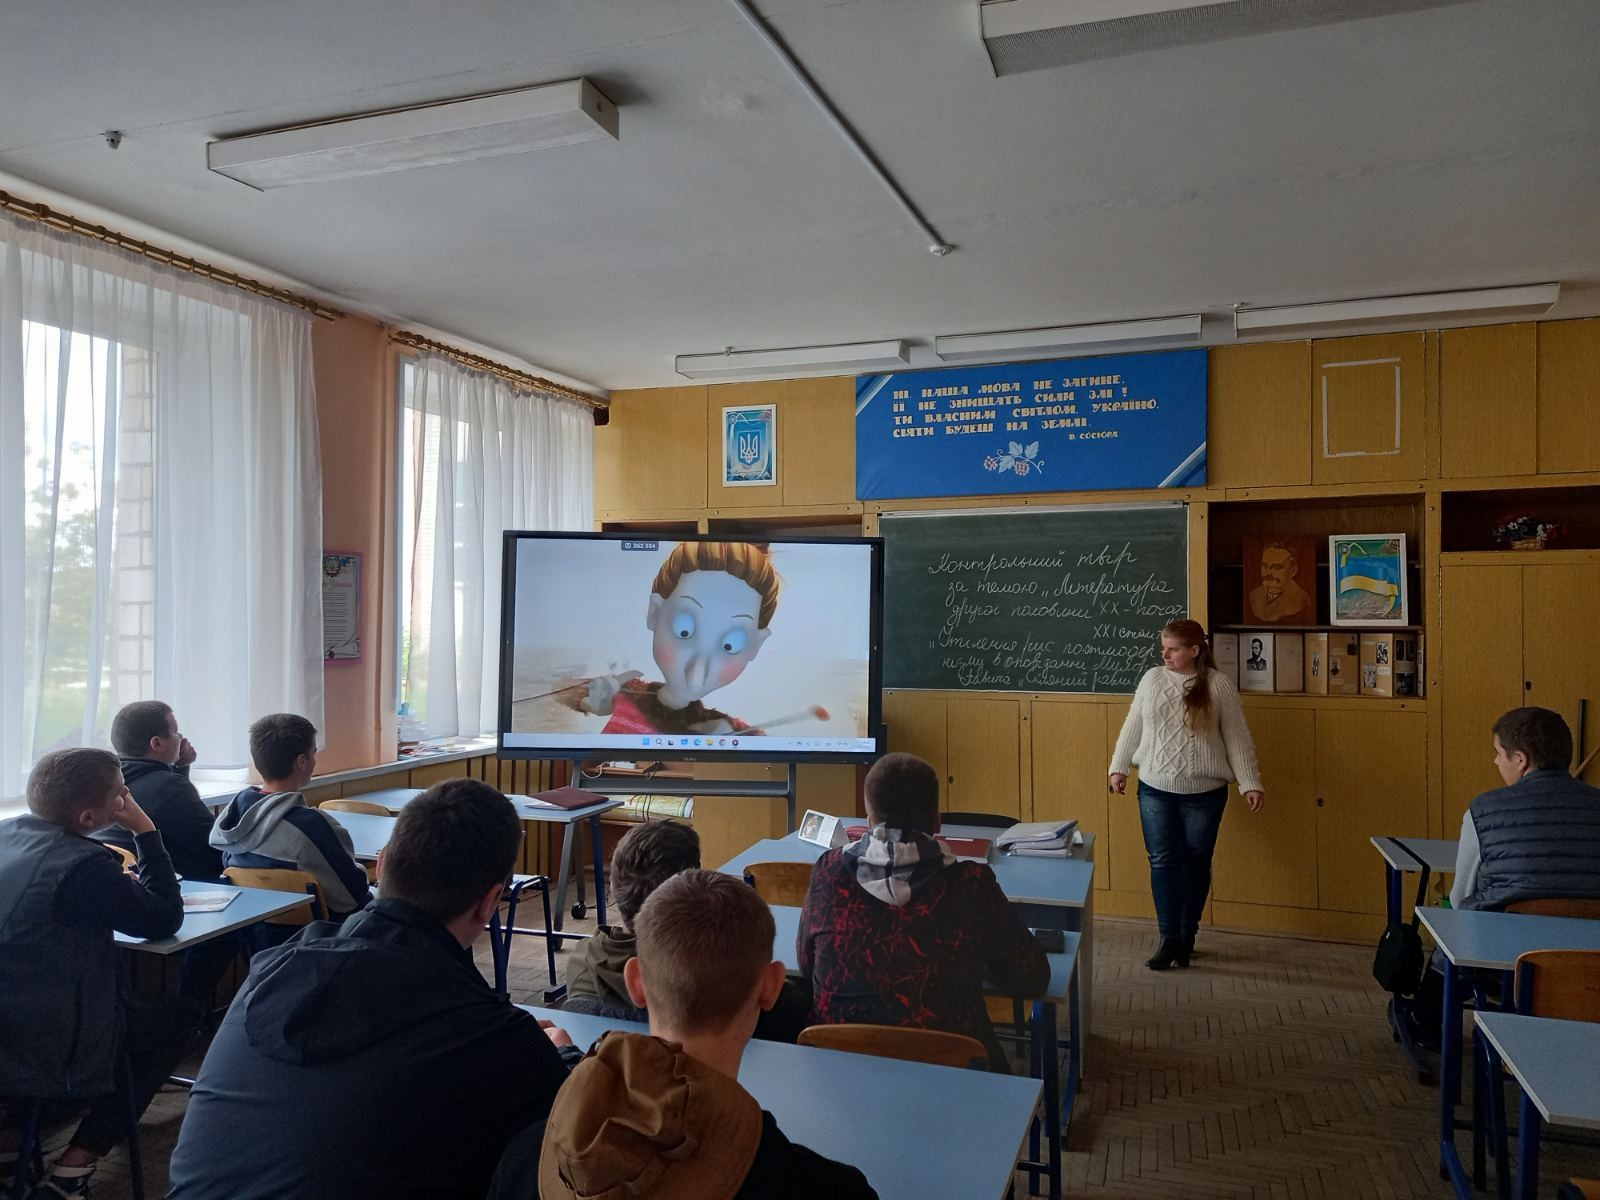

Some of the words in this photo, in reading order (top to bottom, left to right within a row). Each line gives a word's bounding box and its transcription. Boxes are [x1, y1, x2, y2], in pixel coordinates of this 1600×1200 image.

[921, 385, 969, 398] НАША
[978, 382, 1021, 393] МОВА
[1033, 379, 1053, 390] НЕ
[892, 401, 905, 413] ЇЇ
[918, 400, 937, 411] НЕ
[1034, 391, 1075, 403] СИЛИ
[1088, 389, 1113, 400] ЗЛІ
[892, 426, 935, 438] СІЯТИ
[945, 422, 994, 435] БУДЕШ
[1006, 420, 1028, 431] НА
[893, 415, 913, 425] ТИ
[924, 410, 996, 424] ВЛАСНИМ
[1079, 430, 1120, 440] СОСЮРА
[928, 549, 1066, 581] Контрольний
[1077, 541, 1138, 578] твір
[945, 581, 969, 607] за
[977, 580, 1038, 594] темою
[946, 597, 1001, 627] другої
[1010, 602, 1092, 619] половини
[1021, 632, 1055, 660] рис
